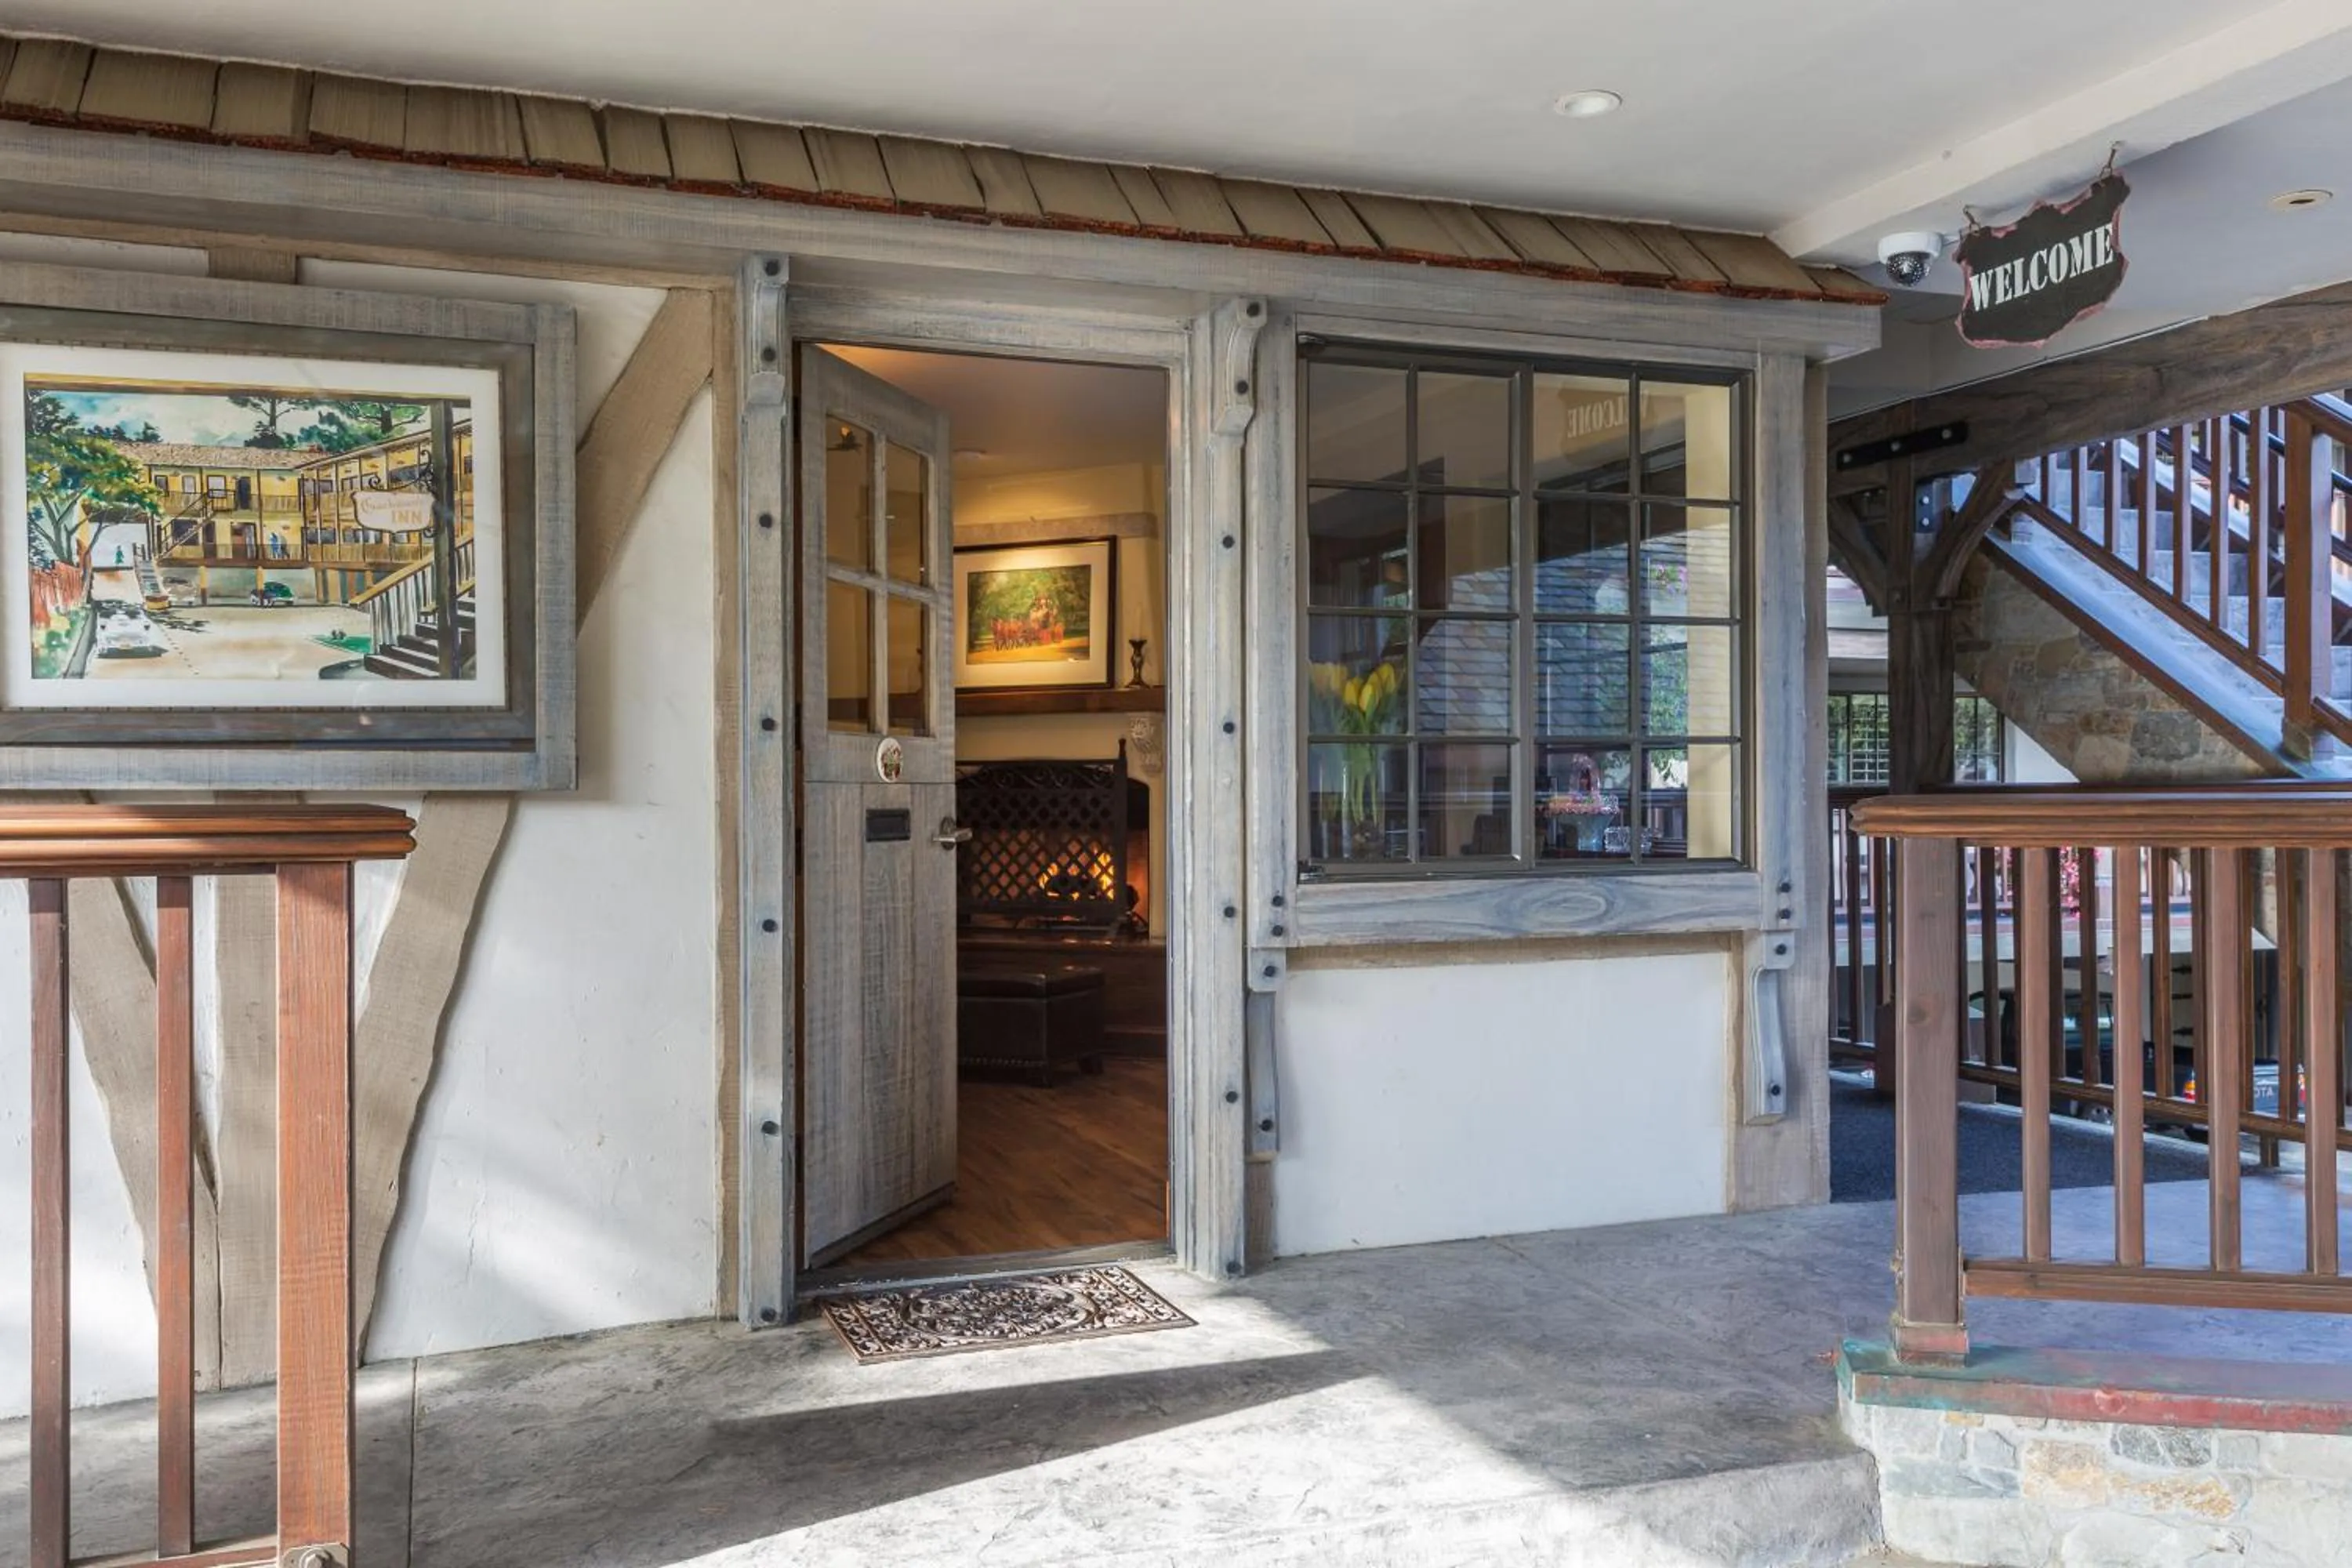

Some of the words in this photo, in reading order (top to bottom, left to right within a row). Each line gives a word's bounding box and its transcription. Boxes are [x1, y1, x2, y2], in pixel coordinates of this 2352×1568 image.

[1969, 223, 2114, 311] WELCOME
[392, 510, 422, 524] INN
[2254, 1086, 2274, 1098] OTA
